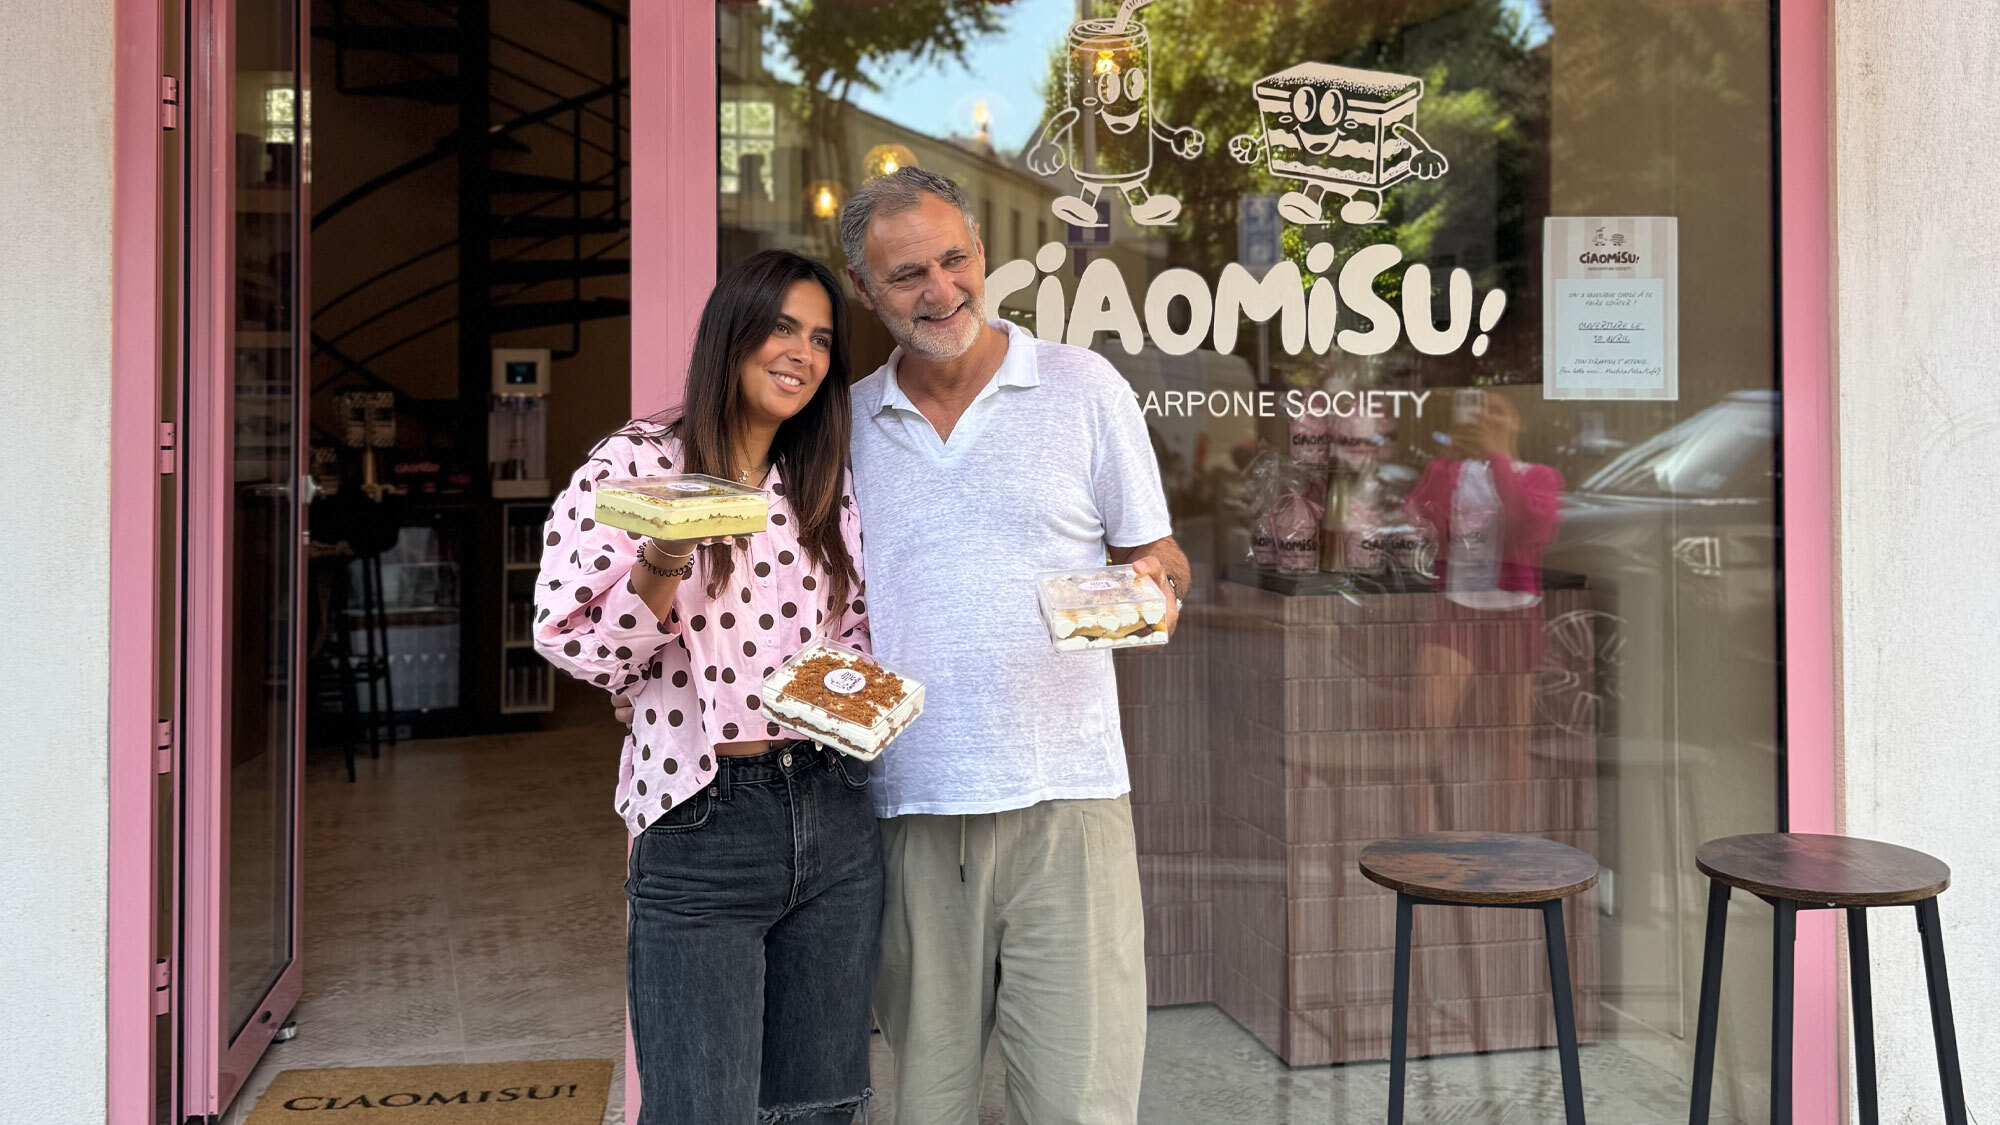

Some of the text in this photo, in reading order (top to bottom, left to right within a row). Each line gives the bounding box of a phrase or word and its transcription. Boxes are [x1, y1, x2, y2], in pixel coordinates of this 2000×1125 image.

[1133, 389, 1431, 418] ARPONE SOCIETY
[283, 1084, 578, 1112] CIAOMISU!
